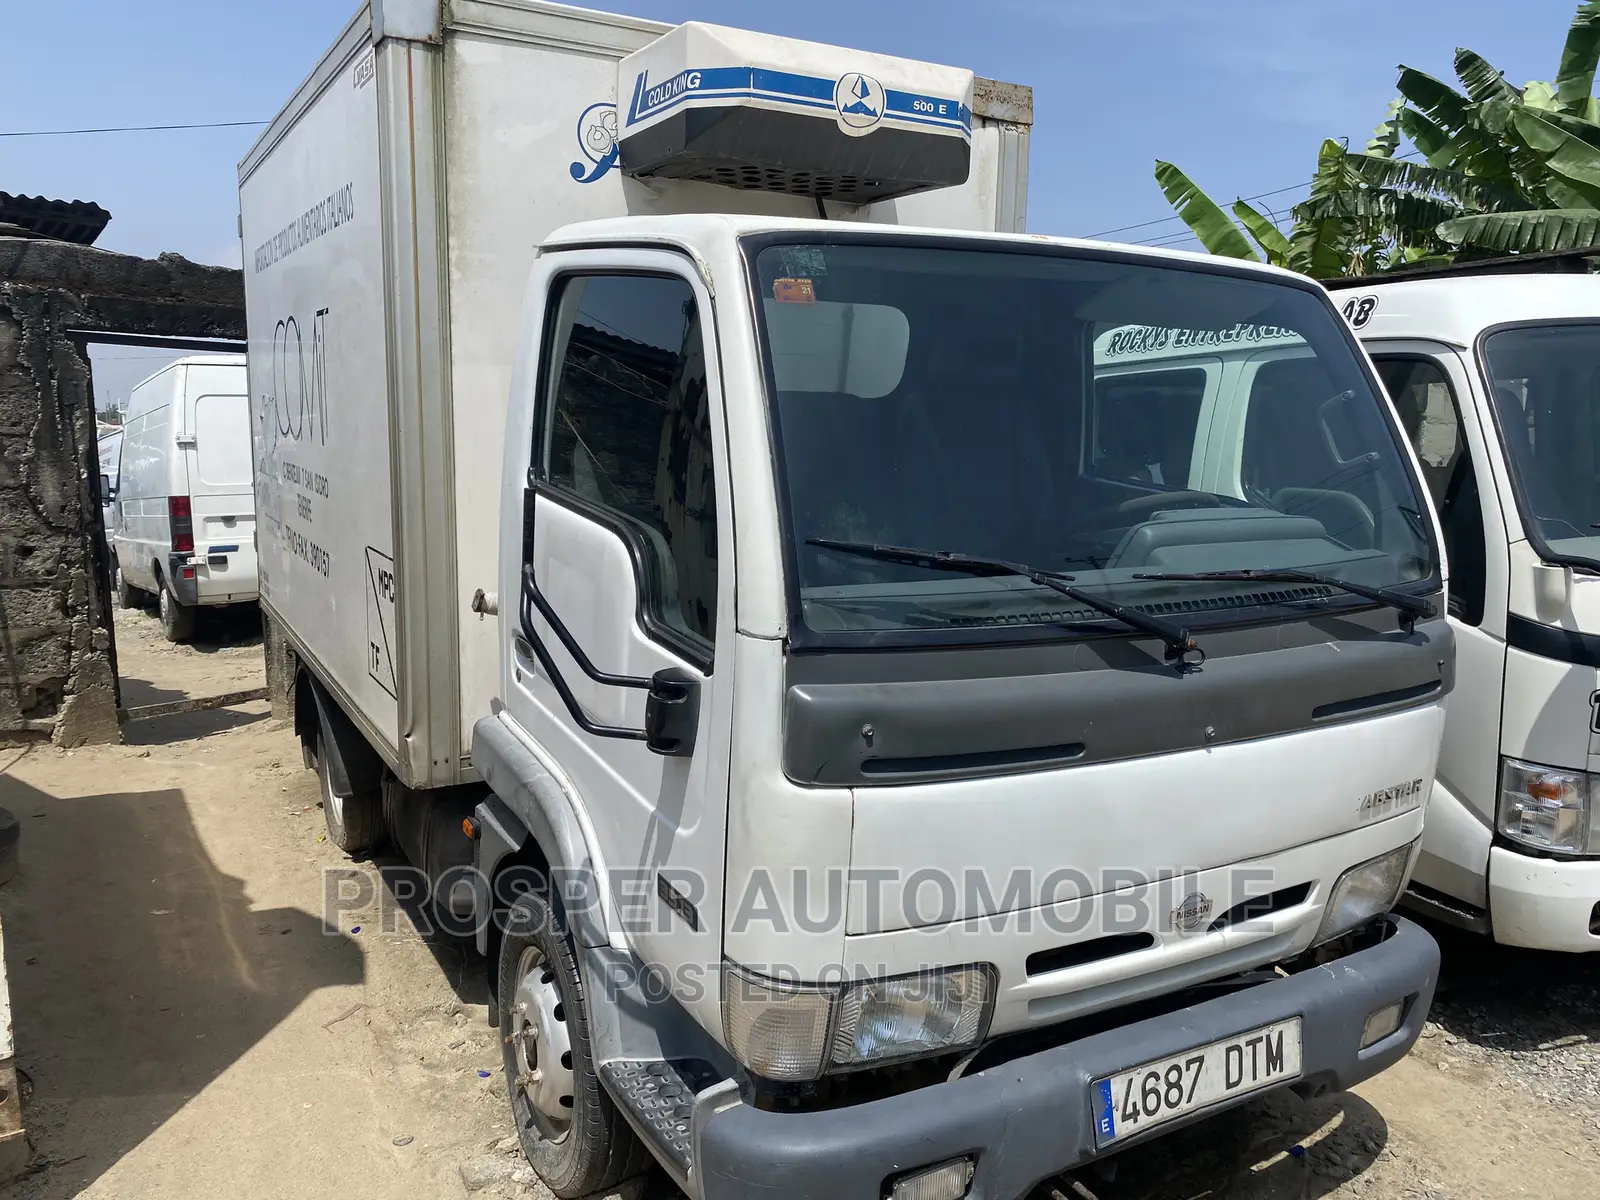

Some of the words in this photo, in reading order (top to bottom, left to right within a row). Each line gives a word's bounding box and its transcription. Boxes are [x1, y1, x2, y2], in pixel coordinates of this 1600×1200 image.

[648, 78, 672, 108] COLD
[672, 71, 702, 96] KING
[913, 100, 934, 114] 500
[938, 105, 947, 115] E
[370, 640, 381, 673] TF
[1176, 904, 1210, 920] NISSAN
[1120, 1054, 1205, 1125] 4687
[1225, 1029, 1284, 1091] DTM
[1101, 1117, 1111, 1133] E
